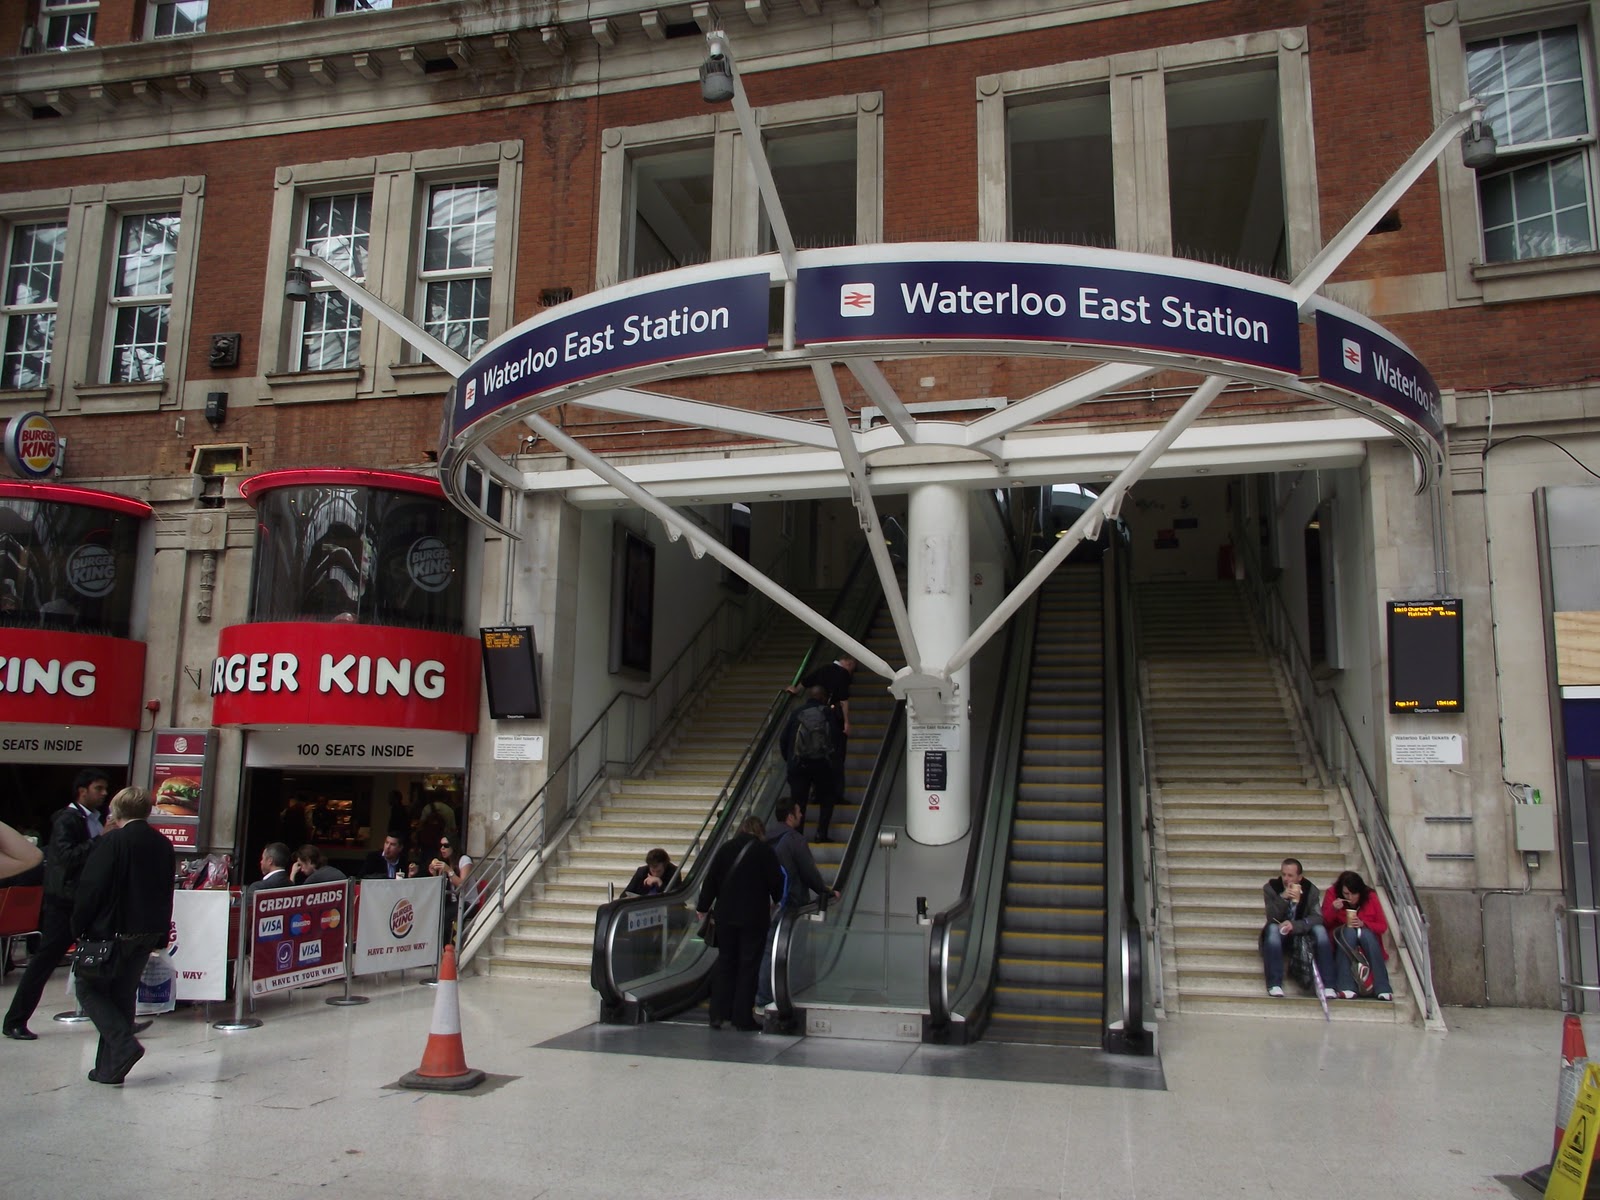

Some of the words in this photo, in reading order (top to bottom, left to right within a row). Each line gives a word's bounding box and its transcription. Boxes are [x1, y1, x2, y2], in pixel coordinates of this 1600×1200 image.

[901, 282, 1066, 317] Waterloo
[1079, 287, 1151, 325] East
[1161, 296, 1269, 344] Station
[483, 346, 558, 396] Waterloo
[564, 325, 615, 363] East
[623, 306, 729, 346] Station
[1372, 351, 1429, 411] Waterloo
[22, 430, 56, 442] BURGER
[21, 441, 56, 458] KING
[72, 555, 115, 570] BURGER
[412, 549, 450, 563] BURGER
[72, 565, 115, 583] KING
[413, 559, 450, 577] KING
[0, 656, 96, 697] ING
[210, 652, 299, 697] RGER
[318, 653, 446, 699] KING
[2, 739, 40, 751] SEATS
[44, 739, 83, 751] INSIDE
[297, 744, 320, 756] 100
[325, 744, 366, 757] SEATS
[371, 744, 414, 757] INSIDE
[259, 895, 304, 913] CREDIT
[306, 889, 343, 906] CARDS
[392, 904, 413, 920] BURGER
[262, 919, 282, 933] VISA
[392, 911, 414, 931] KING
[302, 943, 320, 957] VISA
[367, 947, 384, 956] HAVE
[386, 946, 394, 954] IT
[396, 944, 412, 952] YOUR
[413, 942, 426, 950] WAY
[182, 971, 203, 980] WAY
[272, 976, 291, 987] HAVE
[293, 974, 300, 982] IT
[302, 970, 320, 980] YOUR
[322, 966, 336, 975] WAY
